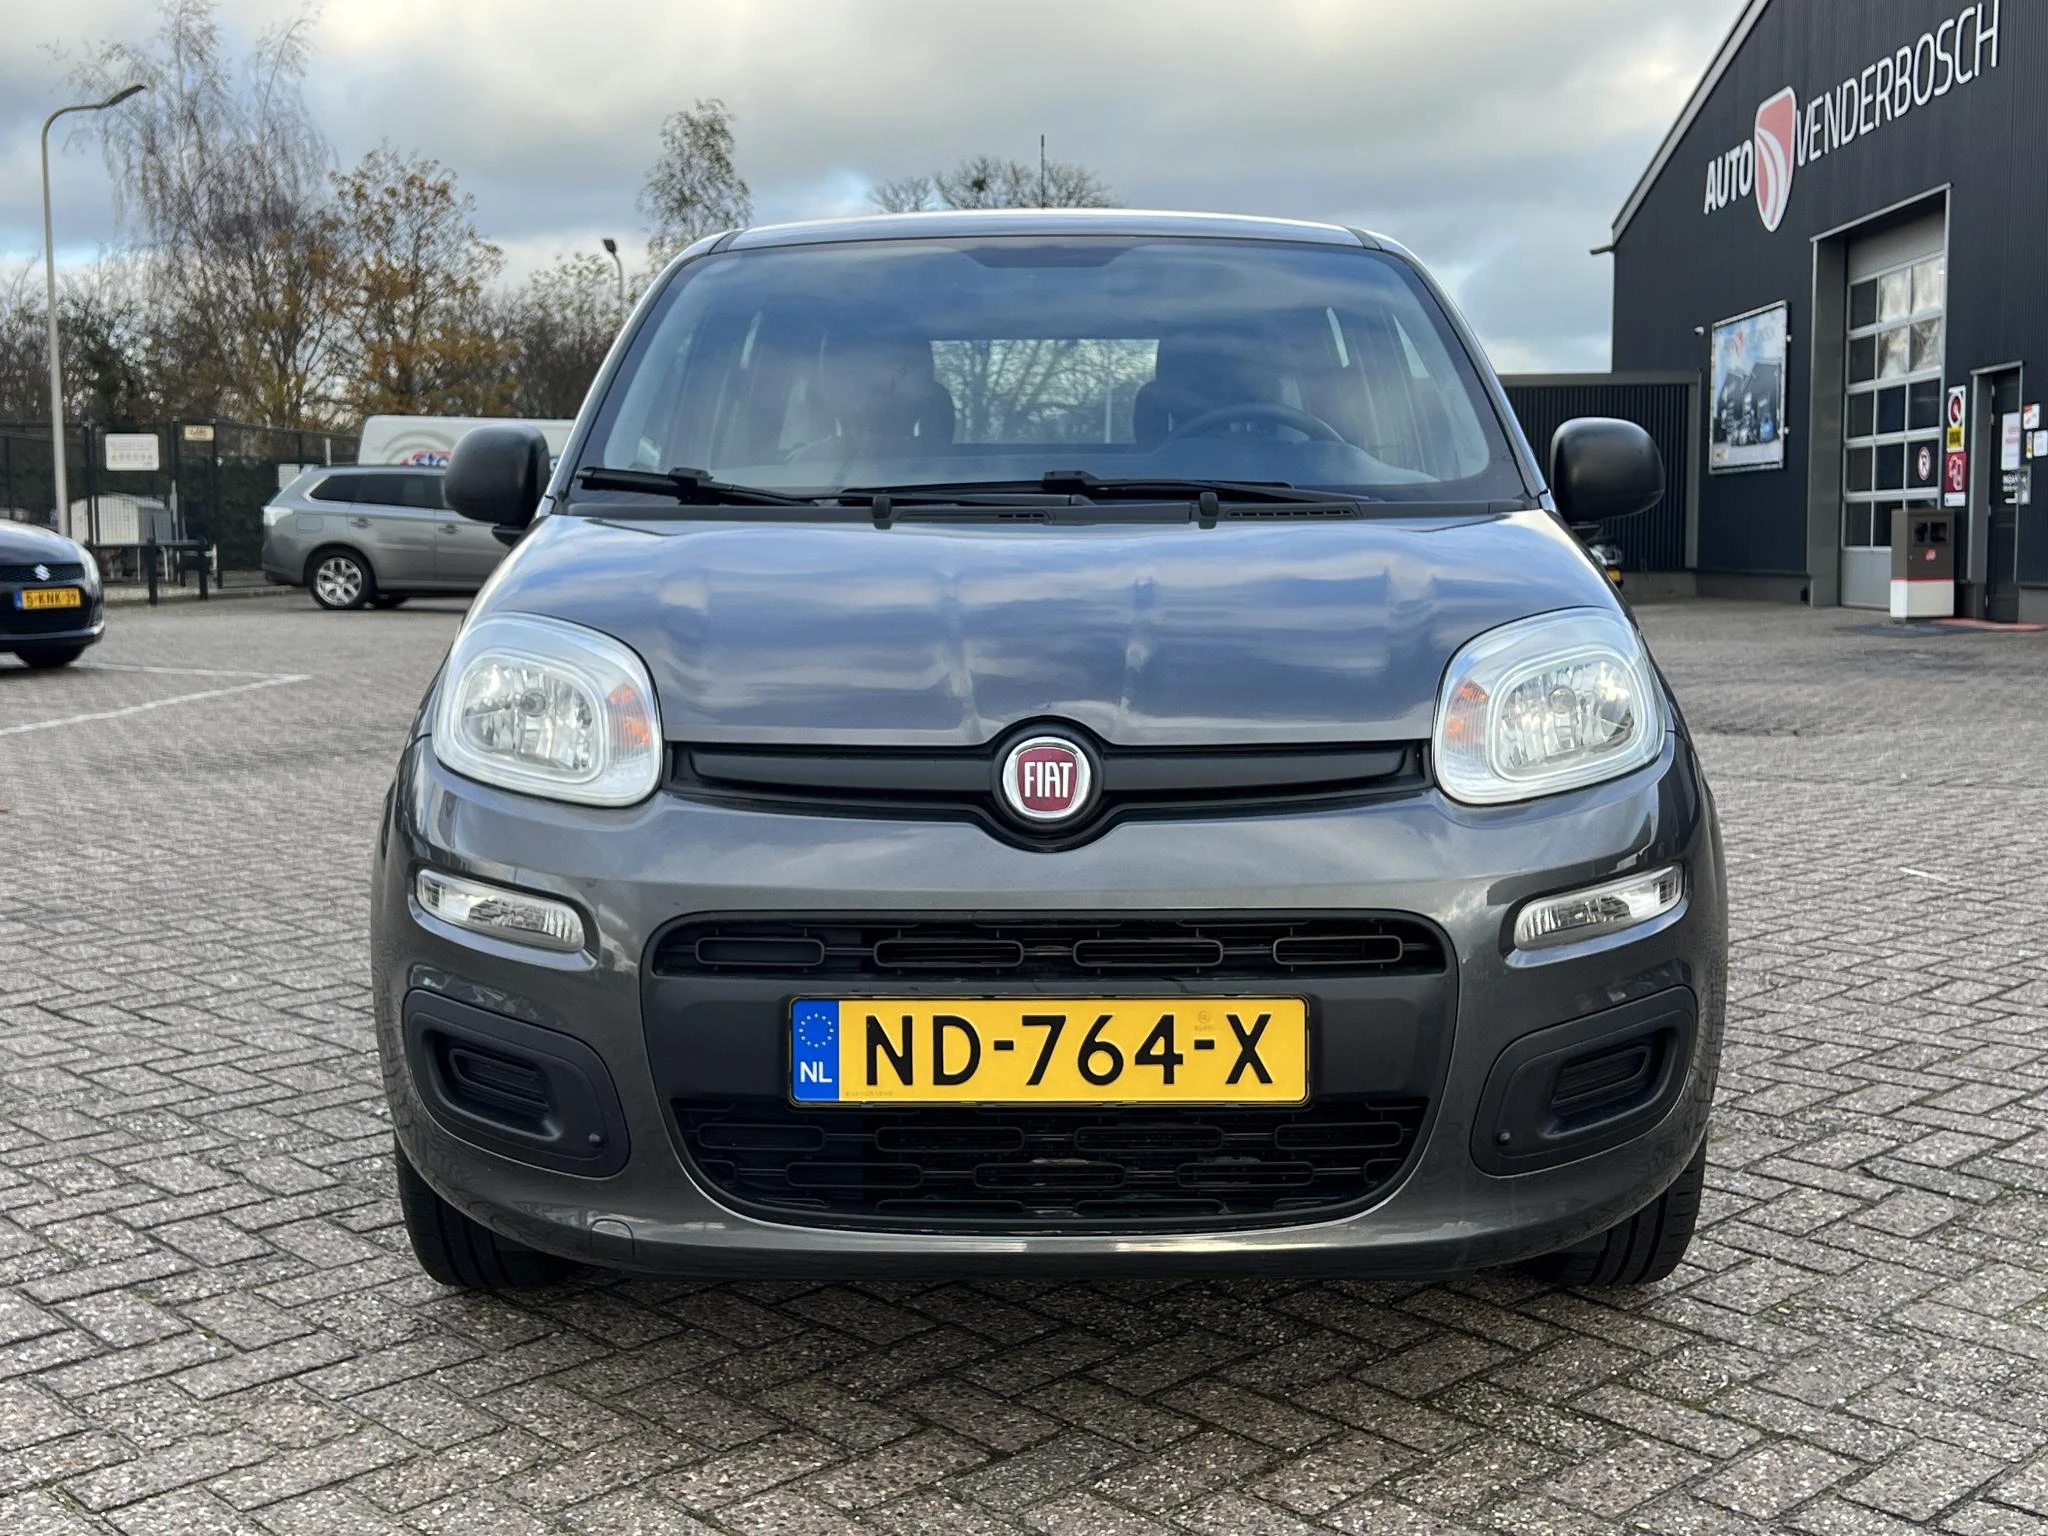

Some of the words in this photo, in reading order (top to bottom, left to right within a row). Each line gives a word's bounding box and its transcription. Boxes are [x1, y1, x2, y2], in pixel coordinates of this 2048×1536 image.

[1703, 139, 1754, 215] AUTO
[1796, 0, 2000, 167] VENDERBOSCH
[1024, 761, 1074, 799] FIAT
[800, 1061, 833, 1083] NL
[864, 1013, 1274, 1087] ND-764-X
